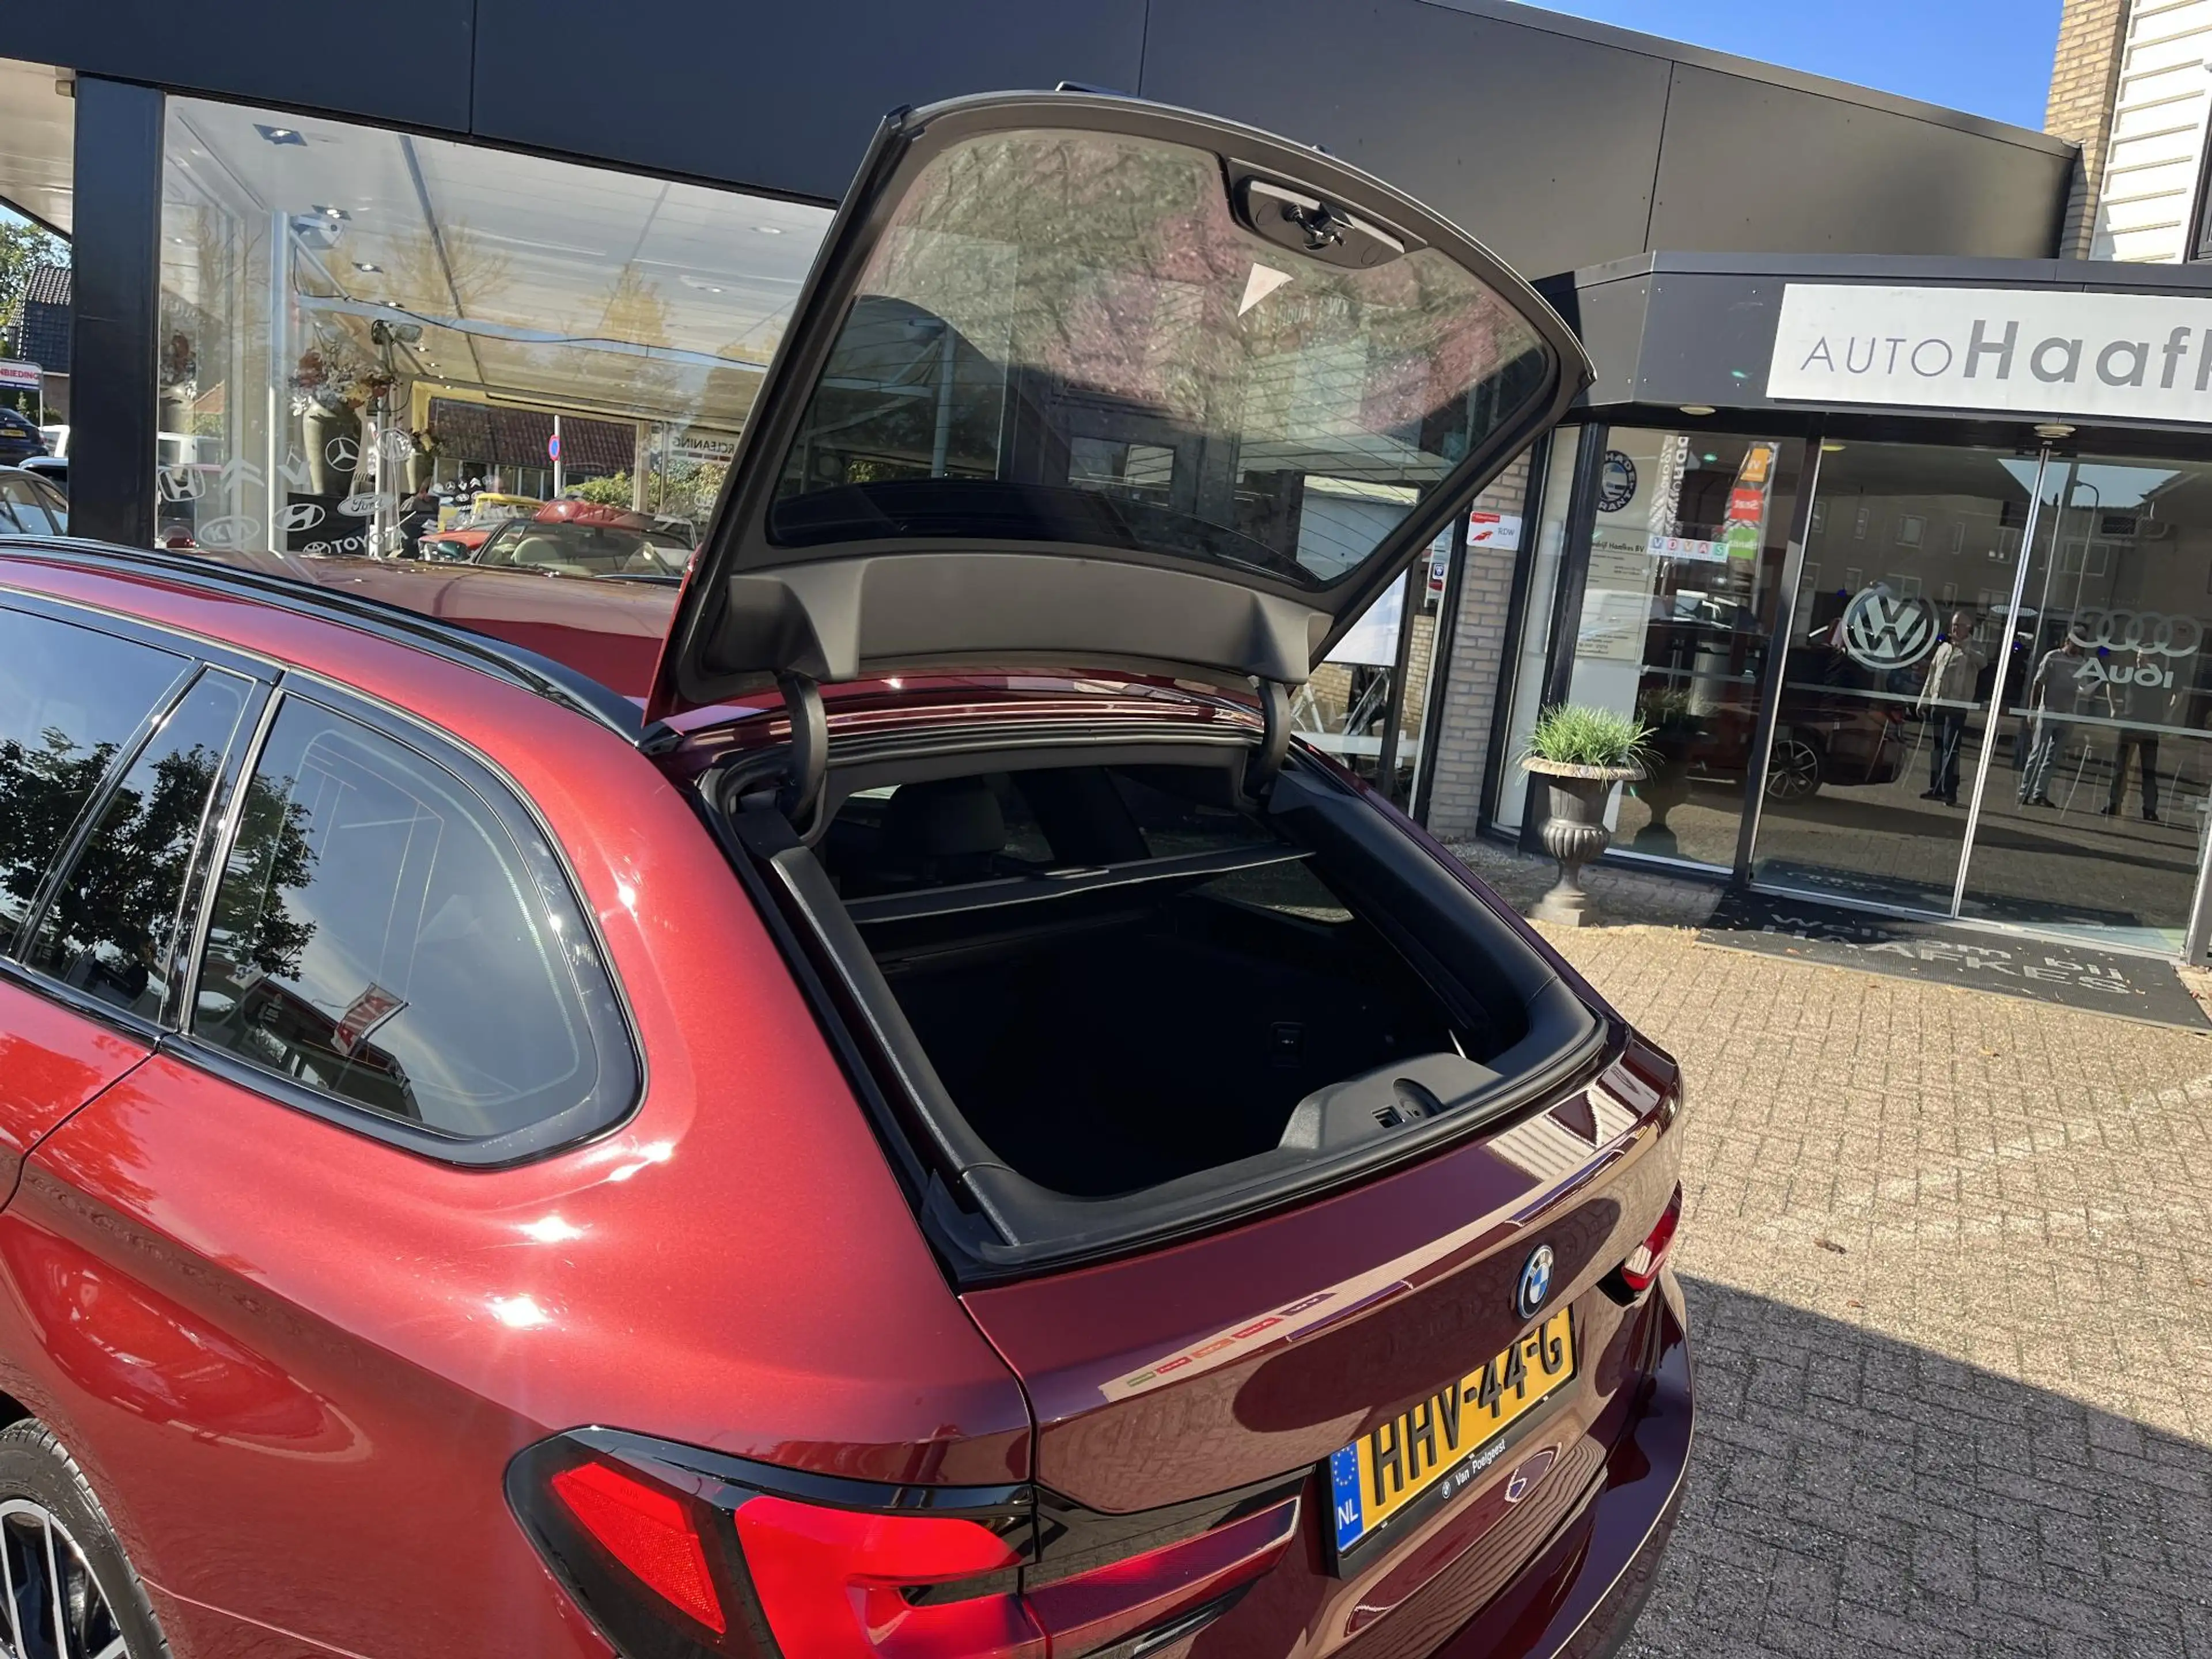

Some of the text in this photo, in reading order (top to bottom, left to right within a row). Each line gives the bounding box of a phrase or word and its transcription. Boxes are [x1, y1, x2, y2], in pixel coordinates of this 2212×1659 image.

[1800, 336, 1953, 377] AUTO
[2073, 657, 2174, 688] Audi
[1371, 1314, 1563, 1507] HHV-44-G
[1455, 1438, 1506, 1486] Van Poelgeest
[1338, 1503, 1359, 1531] NL
